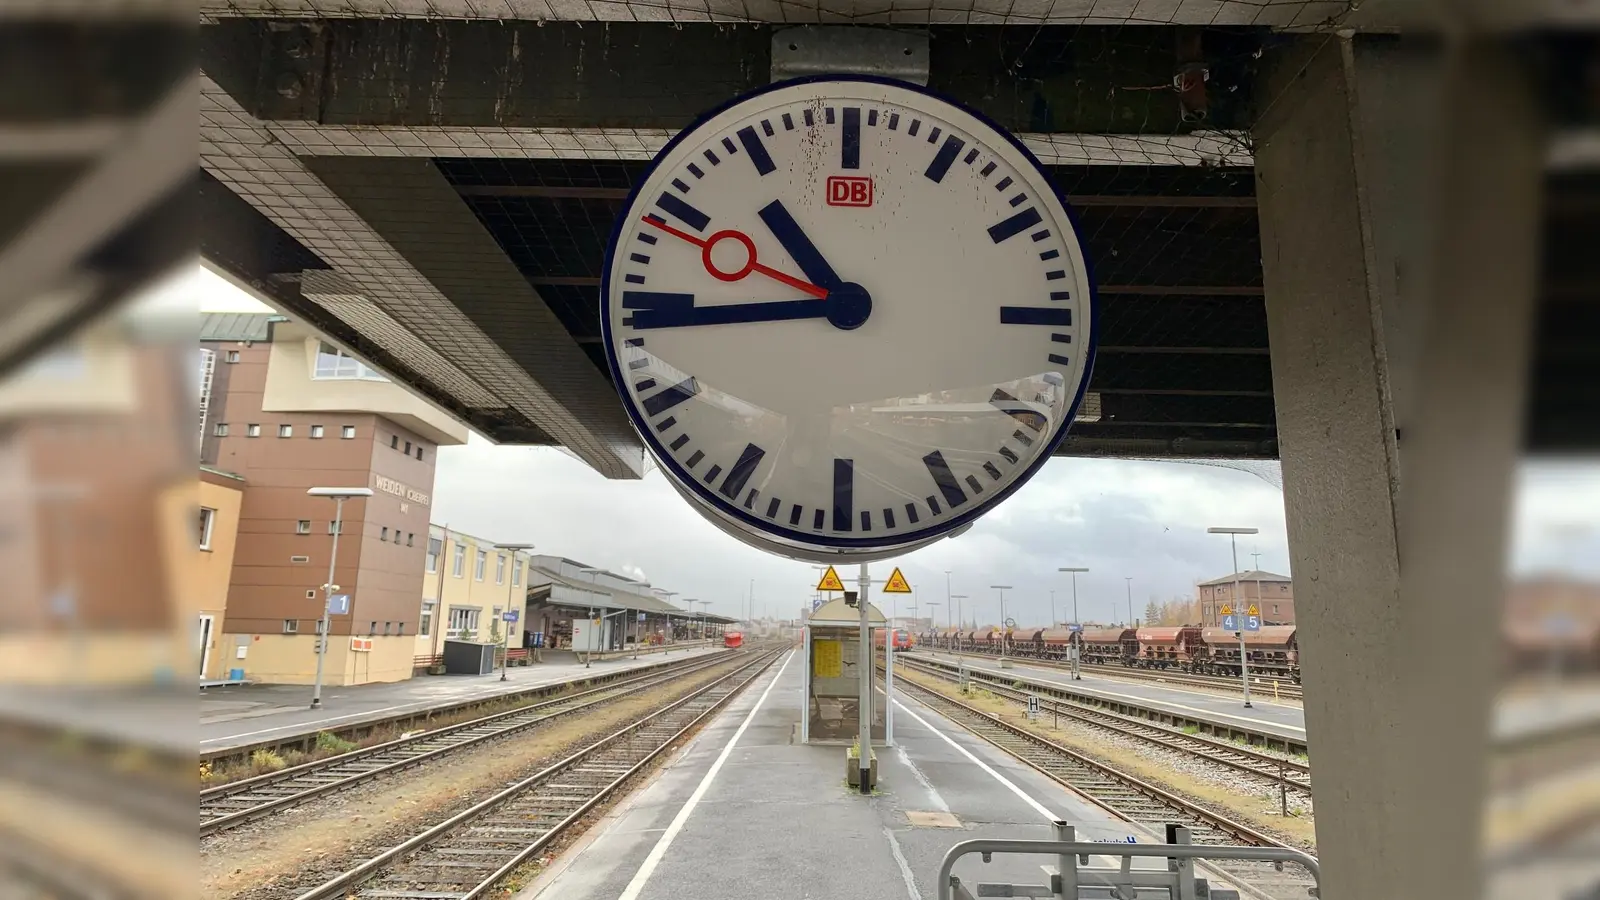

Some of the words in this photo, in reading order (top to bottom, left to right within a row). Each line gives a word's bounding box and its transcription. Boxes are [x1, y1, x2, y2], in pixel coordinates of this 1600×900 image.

[832, 181, 867, 202] DB
[375, 474, 405, 498] WEIDEN
[340, 595, 347, 611] 1
[1225, 616, 1233, 628] 4
[1249, 616, 1257, 628] 5
[1029, 697, 1038, 711] H
